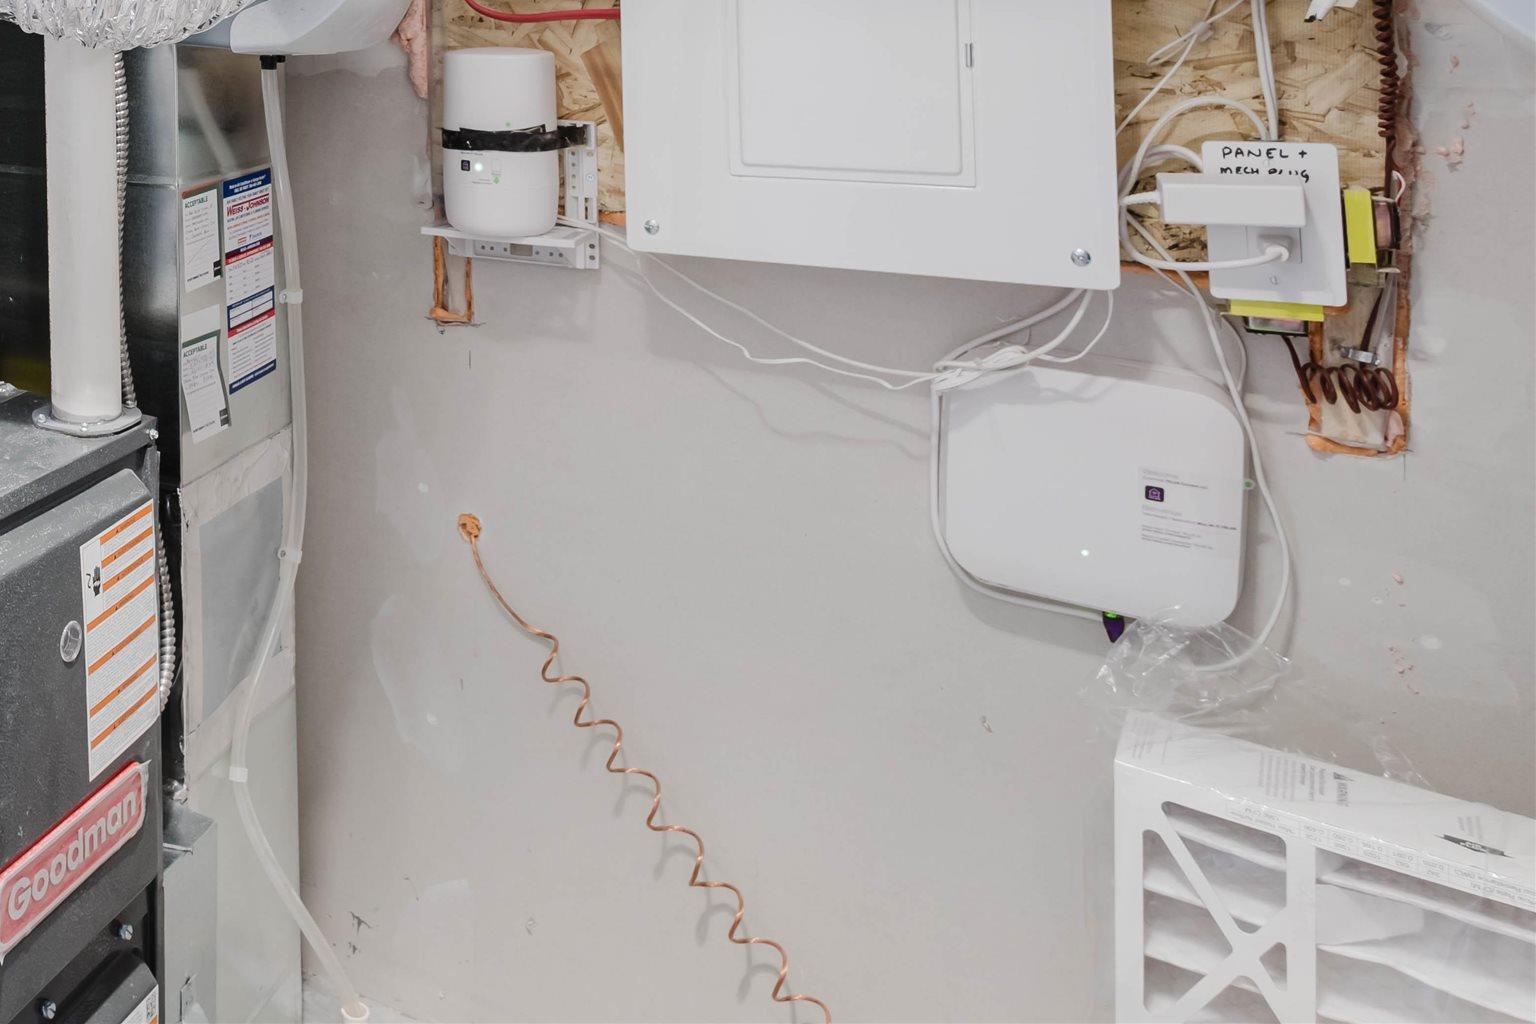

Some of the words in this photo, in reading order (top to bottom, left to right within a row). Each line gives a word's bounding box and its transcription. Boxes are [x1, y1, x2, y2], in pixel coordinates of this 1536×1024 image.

[1222, 147, 1290, 159] PANEL
[1220, 165, 1260, 175] MECH
[184, 195, 209, 209] ACCEPTABLE
[183, 343, 208, 358] ACCEPTABLE
[7, 790, 139, 921] Goodman
